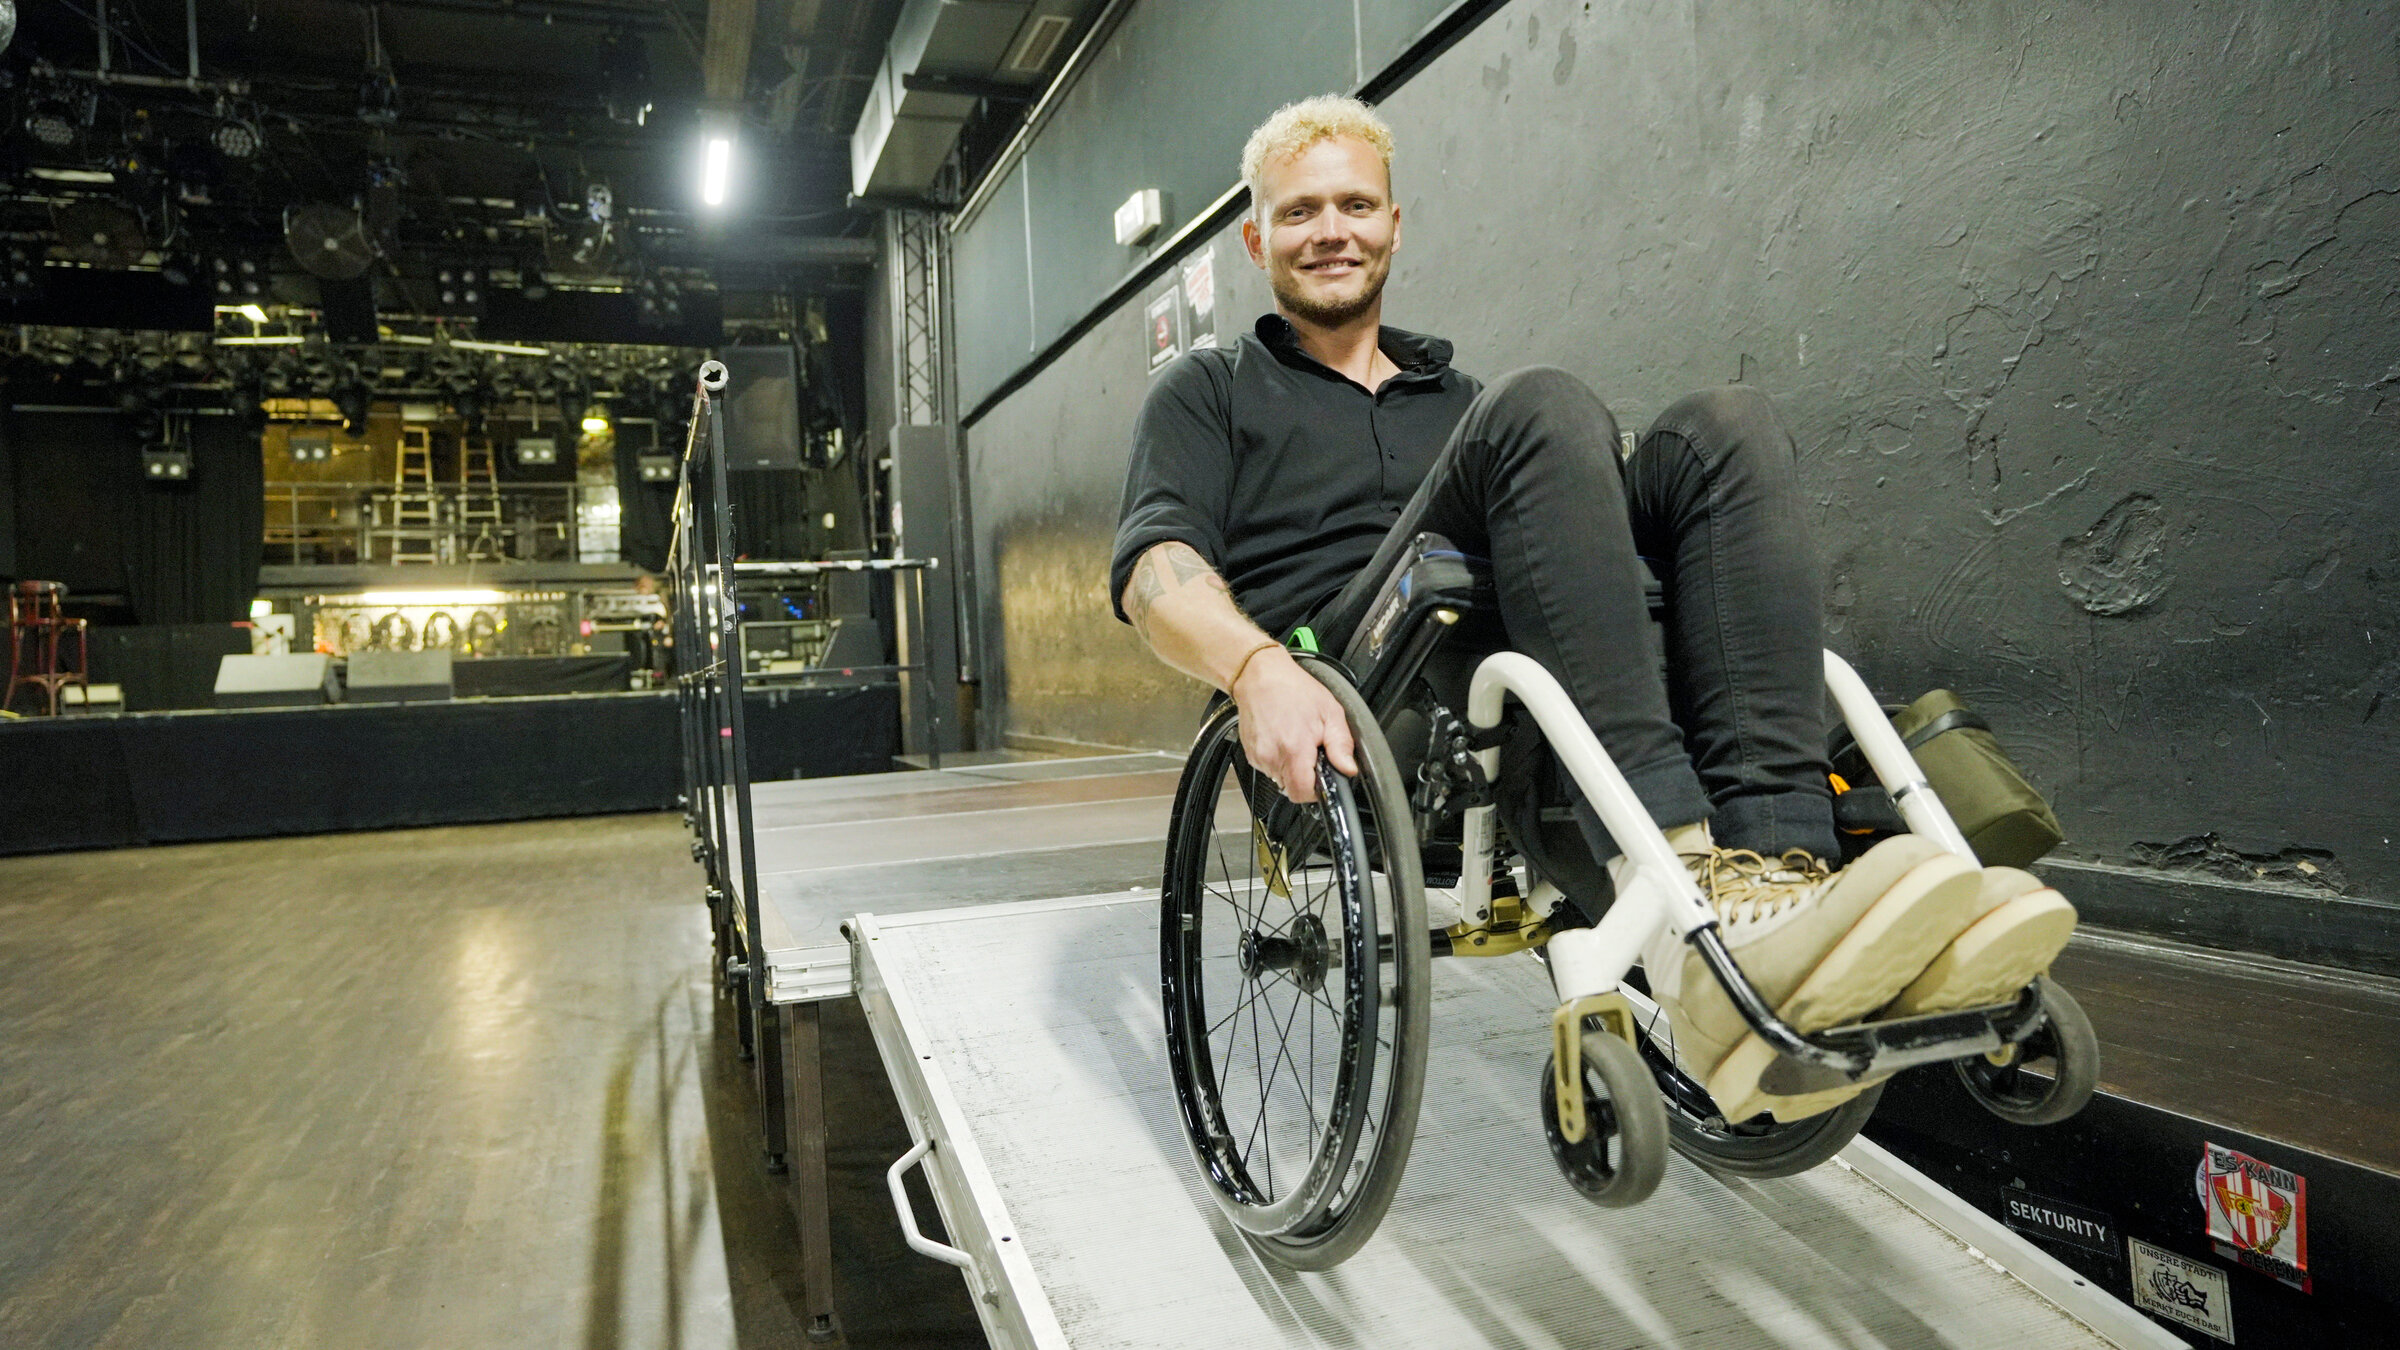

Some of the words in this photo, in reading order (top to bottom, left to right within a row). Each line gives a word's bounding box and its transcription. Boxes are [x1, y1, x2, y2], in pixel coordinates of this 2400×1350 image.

[2242, 1160, 2298, 1194] KANN
[2009, 1200, 2106, 1242] SEKTURITY
[2139, 1246, 2180, 1268] UNSERE
[2181, 1261, 2217, 1282] STADT!
[2142, 1296, 2174, 1314] MERKT
[2175, 1309, 2201, 1326] EUCH
[2201, 1320, 2221, 1333] DAS!
